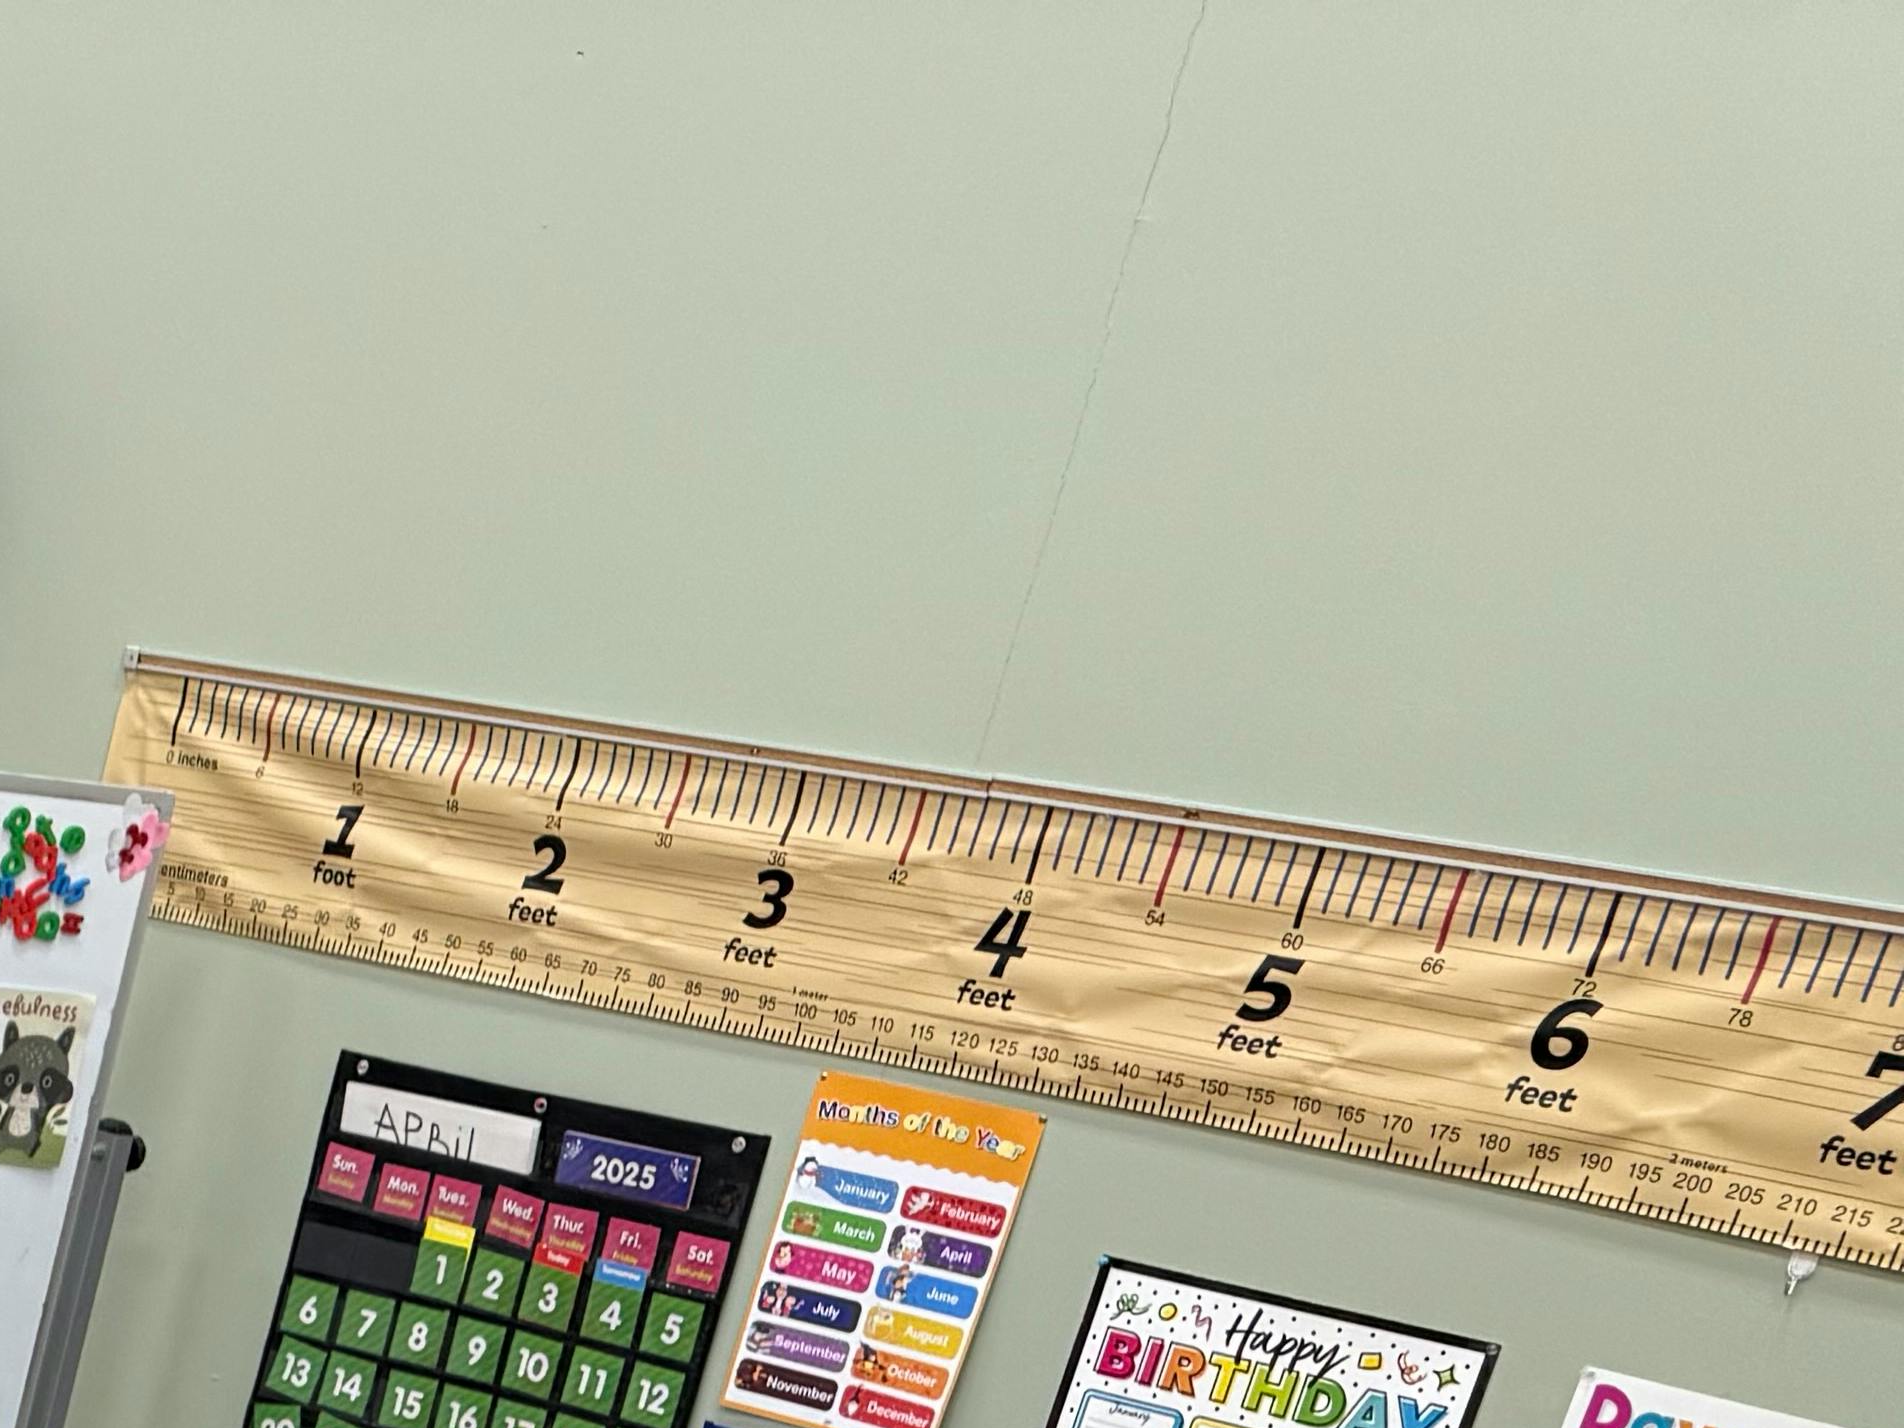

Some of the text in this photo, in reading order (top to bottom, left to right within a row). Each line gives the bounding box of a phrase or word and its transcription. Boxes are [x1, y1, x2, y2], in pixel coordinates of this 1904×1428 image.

[166, 751, 219, 771] 0 inches
[322, 804, 365, 859] 1
[521, 834, 567, 895] 2
[742, 869, 795, 930] 3
[974, 906, 1032, 979] 4
[1235, 954, 1306, 1022] 5
[1530, 998, 1605, 1071] 6
[446, 799, 1754, 1028] 18 24 30 36 42 48 54 60 66 72 78
[313, 860, 1898, 1176] foot feet feet feet feet feet feet
[818, 1099, 1027, 1162] Months of the Year
[1199, 1078, 1819, 1217] 150 200 205 210
[590, 1153, 658, 1191] 2025
[1680, 1157, 1729, 1175] meters
[332, 1153, 359, 1175] Sun.
[386, 1175, 421, 1196] Mon.
[437, 1185, 470, 1207] Tues.
[501, 1197, 535, 1223] Wed.
[619, 1229, 643, 1250] Fri.
[687, 1244, 715, 1266] Sat.
[834, 1177, 1001, 1229] January February
[832, 1220, 974, 1266] March April
[435, 1254, 685, 1346] 1 2 3 4 5
[821, 1261, 960, 1307] May June
[811, 1300, 951, 1348] July August
[1225, 1308, 1352, 1390] Happy
[298, 1295, 671, 1416] 6 7 8 9 10 11 12
[772, 1334, 938, 1390] September October
[281, 1352, 312, 1388] 13
[332, 1366, 363, 1402] 14
[392, 1386, 425, 1420] 15
[765, 1374, 835, 1404] November
[1107, 1402, 1152, 1426] January
